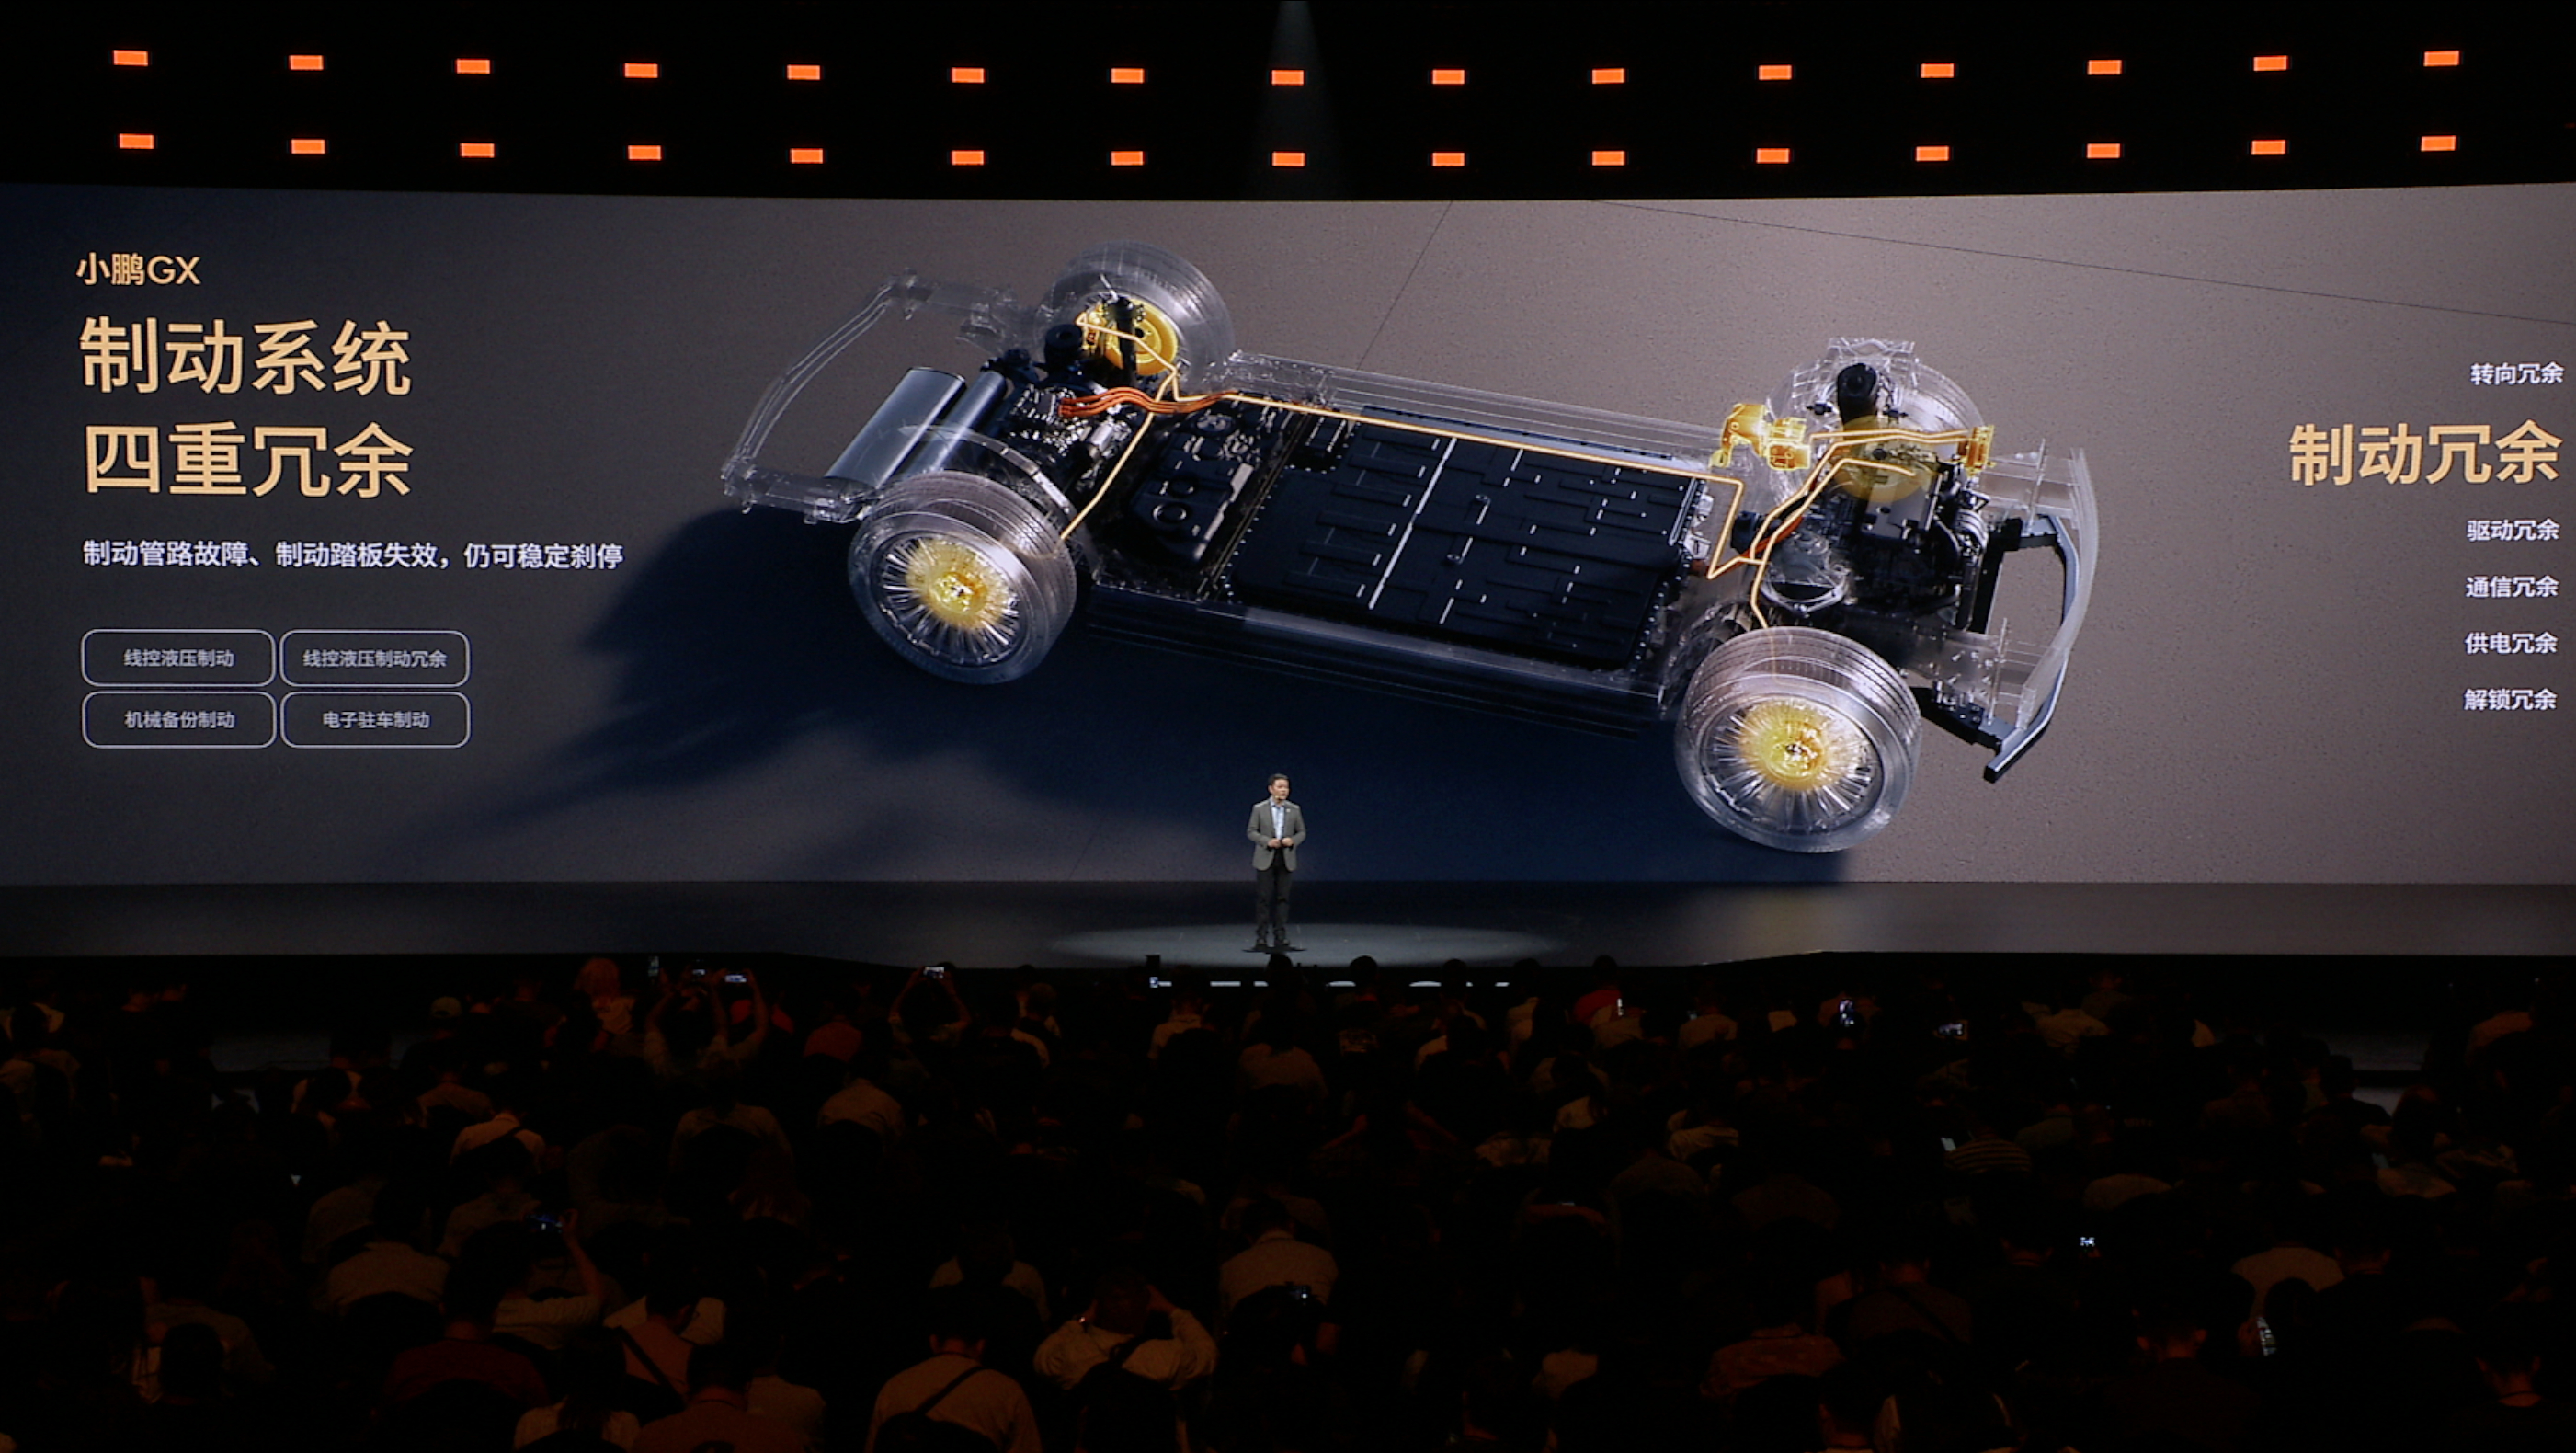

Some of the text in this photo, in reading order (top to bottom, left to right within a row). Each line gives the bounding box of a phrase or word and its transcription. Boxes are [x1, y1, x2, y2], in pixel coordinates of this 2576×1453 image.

[75, 252, 201, 286] 小鹏GX
[79, 315, 412, 396] 制动系统
[2469, 361, 2565, 385] 转向冗余
[85, 421, 414, 498] 四重冗余
[2288, 419, 2563, 486] 制动冗余
[2466, 518, 2560, 542] 驱动冗余
[83, 540, 624, 570] 制动管路故障、制动踏板失效，仍可稳定刹停
[2465, 575, 2559, 598] 通信冗余
[2464, 631, 2559, 655] 供电冗余
[123, 648, 235, 669] 线控液压制动
[302, 648, 449, 669] 线控液压制动冗余
[2463, 688, 2558, 712] 解锁冗余
[124, 710, 235, 730] 机械备份制动
[322, 710, 431, 730] 电子驻车制动
